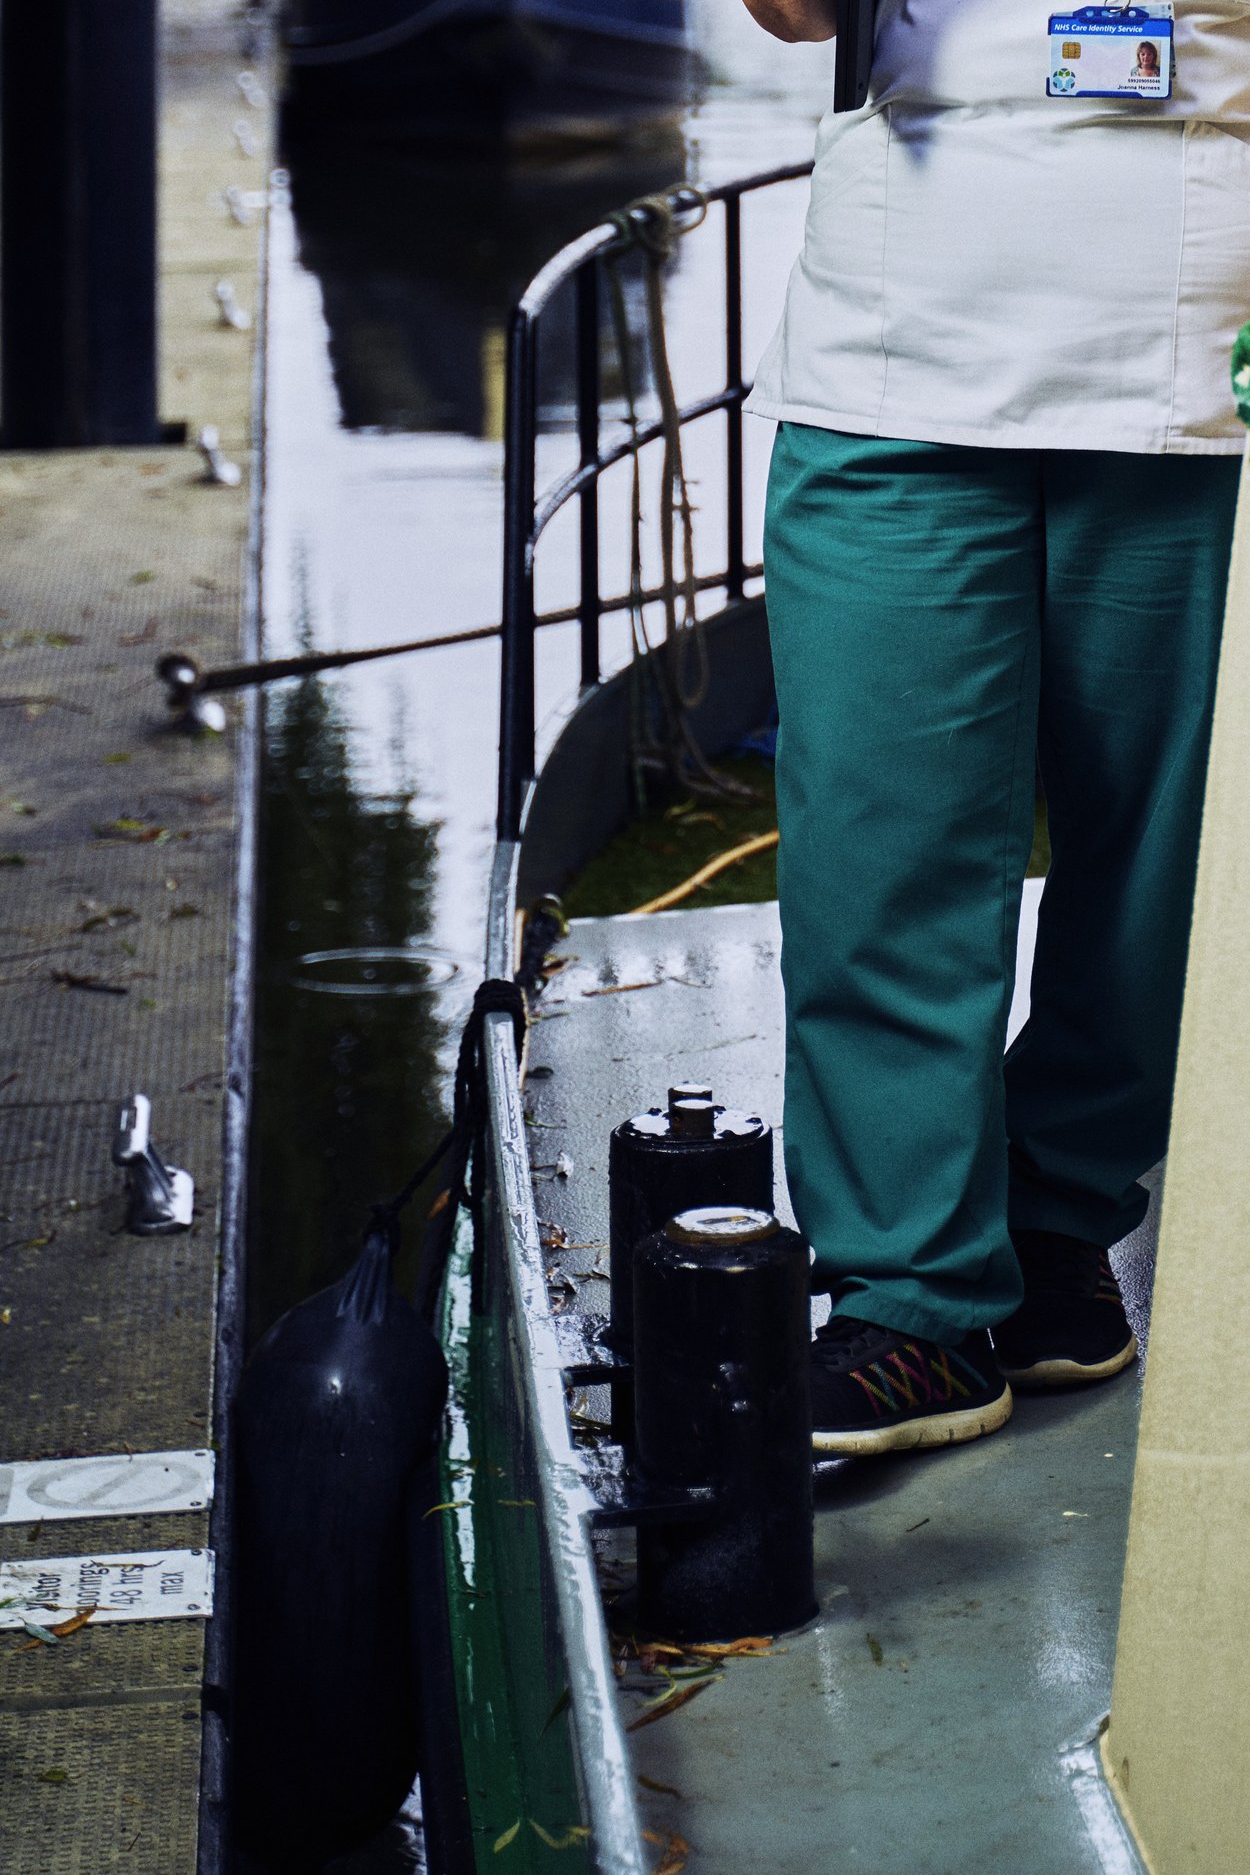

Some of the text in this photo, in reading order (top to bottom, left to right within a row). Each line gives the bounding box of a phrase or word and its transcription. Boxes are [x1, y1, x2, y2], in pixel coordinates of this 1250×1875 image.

[1054, 23, 1143, 33] NHS Care Identity Service
[110, 1566, 145, 1604] 48 hrs
[161, 1571, 184, 1595] max
